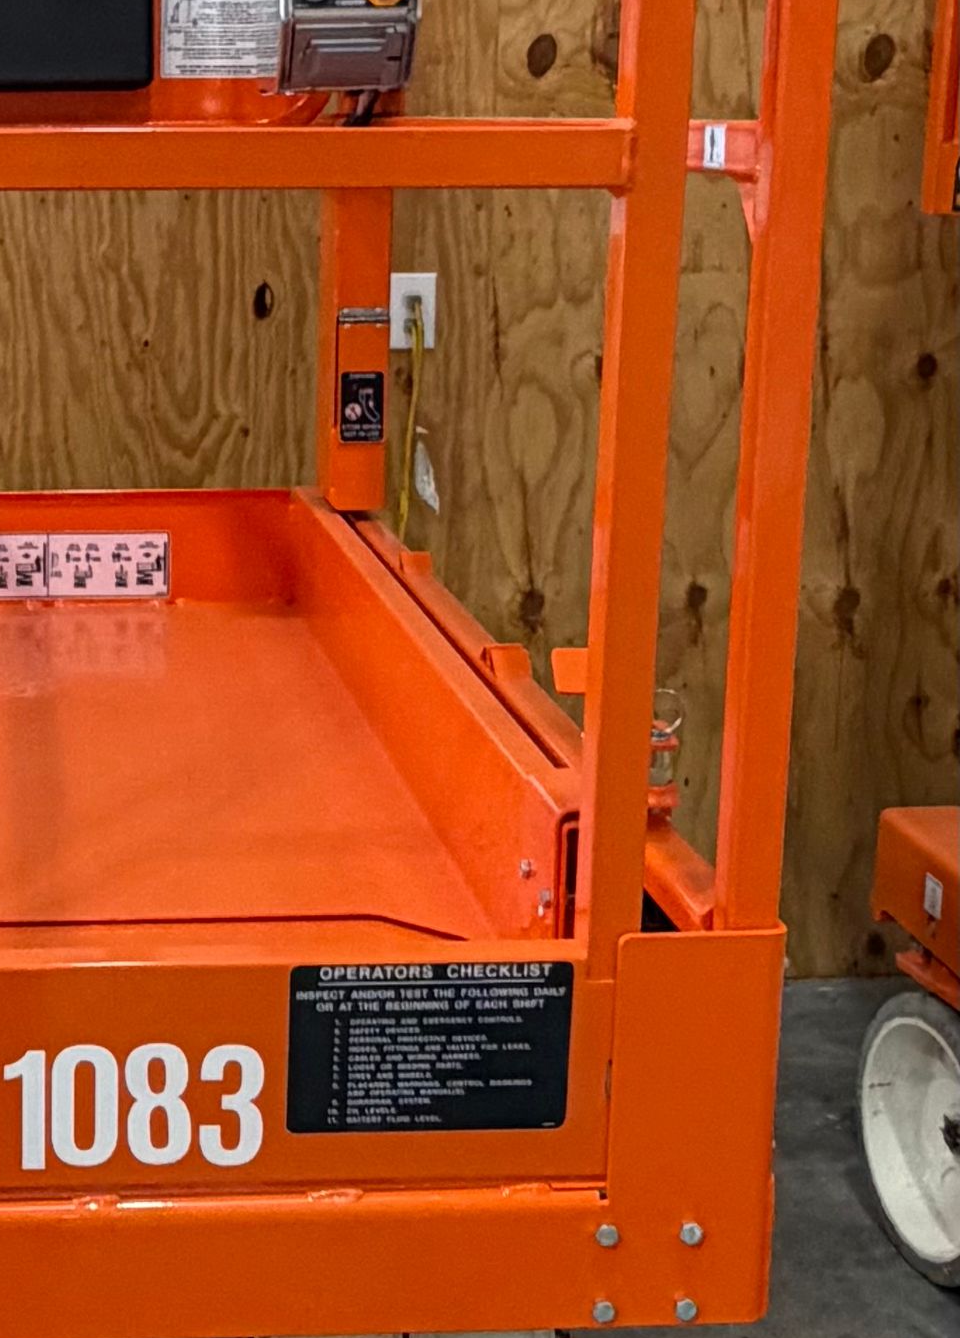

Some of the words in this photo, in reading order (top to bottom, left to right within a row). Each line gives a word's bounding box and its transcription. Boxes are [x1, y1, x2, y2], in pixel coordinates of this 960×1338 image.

[319, 964, 434, 981] OPERATORS
[446, 963, 553, 978] CHECKLIST
[296, 990, 345, 1001] INSPECT
[350, 989, 395, 1000] AND/OR
[400, 988, 429, 999] TEST
[433, 988, 455, 998] THE
[460, 987, 529, 998] FOLLOWING
[533, 986, 566, 997] DAILY
[316, 1002, 334, 1012] OR
[338, 1001, 353, 1012] AT
[359, 1001, 380, 1011] THE
[385, 1000, 449, 1011] BEGINNING
[455, 1000, 470, 1010] OF
[475, 999, 508, 1010] EACH
[512, 999, 545, 1009] SHIFT
[3, 1042, 265, 1170] 1083
